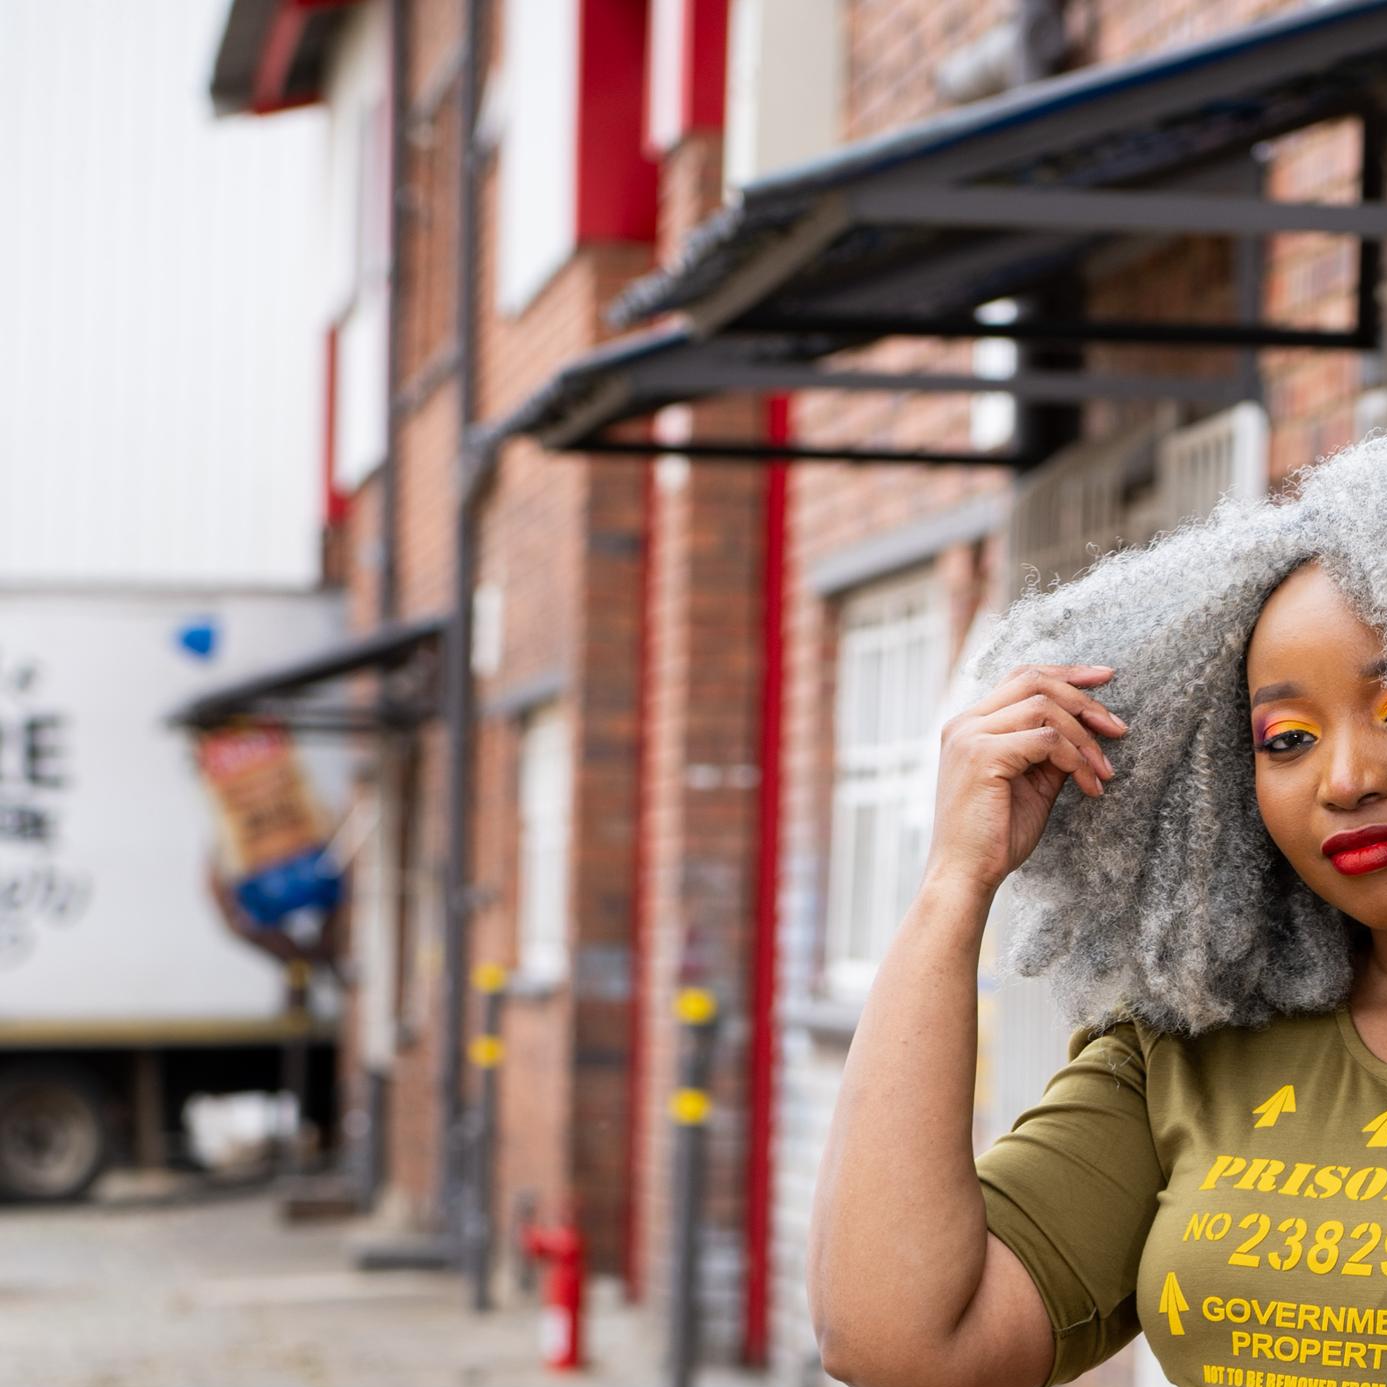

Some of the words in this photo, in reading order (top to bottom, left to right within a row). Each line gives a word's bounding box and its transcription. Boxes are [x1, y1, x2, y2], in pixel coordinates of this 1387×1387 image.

[1184, 1213, 1232, 1241] NO
[1203, 1364, 1226, 1384] NOT
[1226, 1367, 1244, 1387] TO
